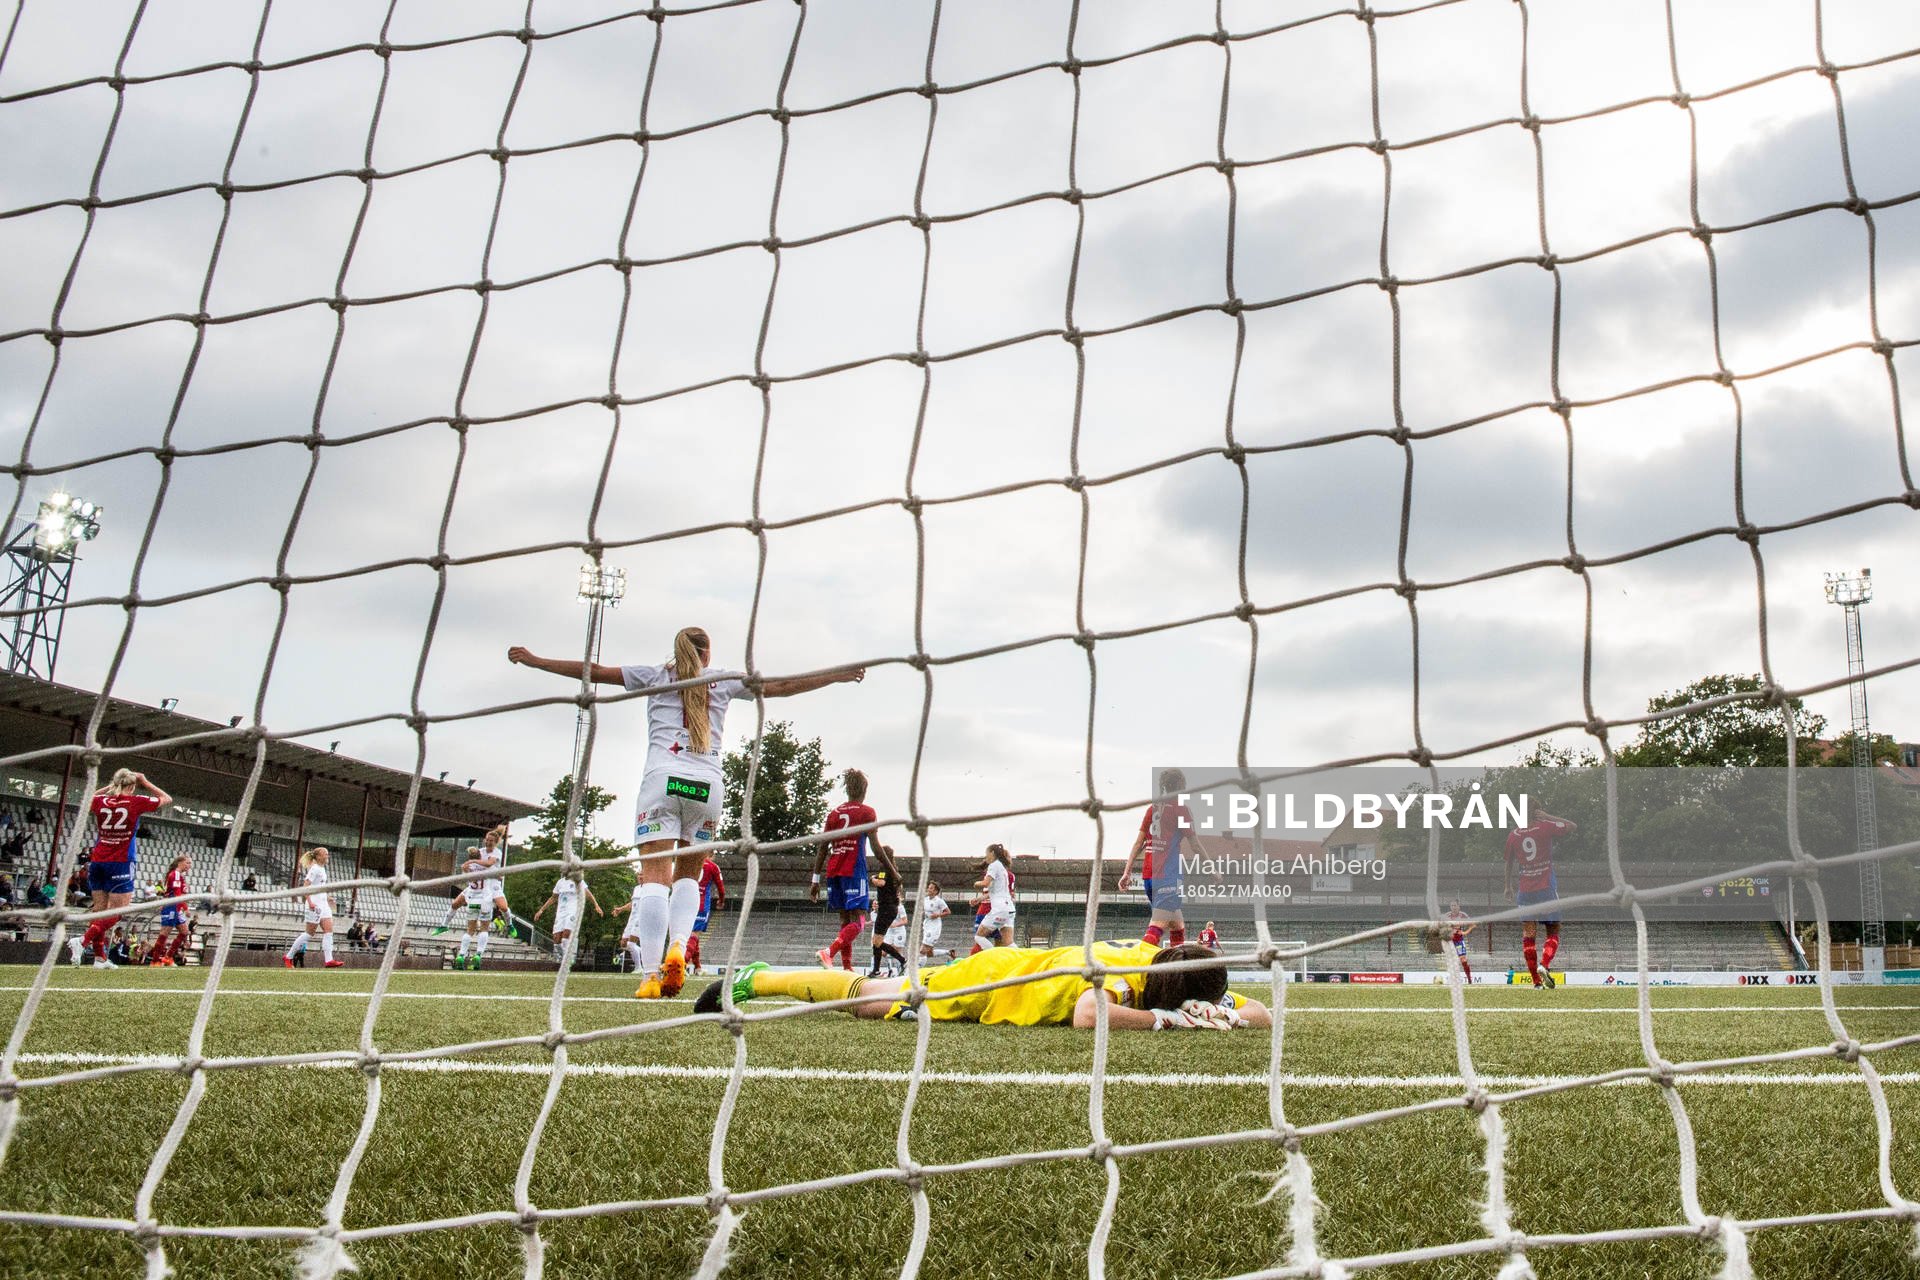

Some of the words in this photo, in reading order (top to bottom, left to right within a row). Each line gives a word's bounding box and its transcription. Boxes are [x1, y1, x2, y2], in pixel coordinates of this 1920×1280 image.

[668, 781, 696, 795] akea
[100, 807, 128, 830] 22
[1522, 836, 1537, 862] 9
[1747, 975, 1770, 985] IXX
[1795, 974, 1817, 984] IXX
